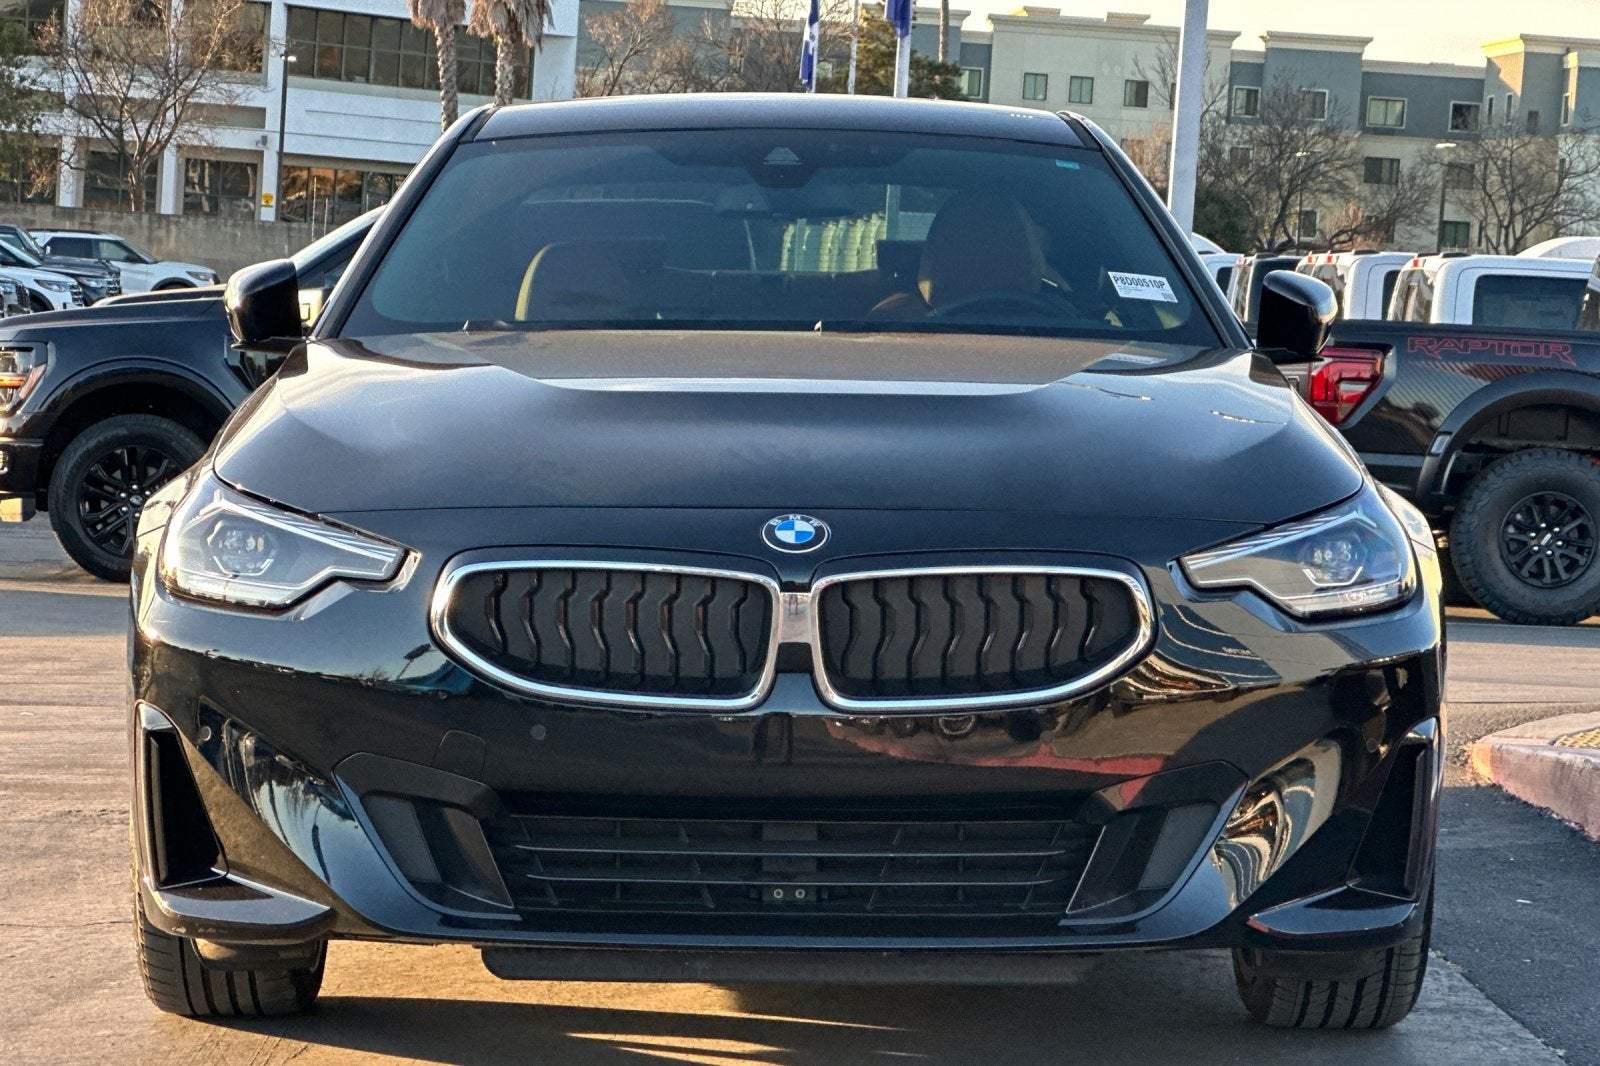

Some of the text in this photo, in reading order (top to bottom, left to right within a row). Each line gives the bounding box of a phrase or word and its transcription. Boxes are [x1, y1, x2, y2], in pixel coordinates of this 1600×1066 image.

[1112, 276, 1165, 289] P8D00510P
[1407, 337, 1576, 366] RAPTOR
[769, 515, 822, 527] BMW
